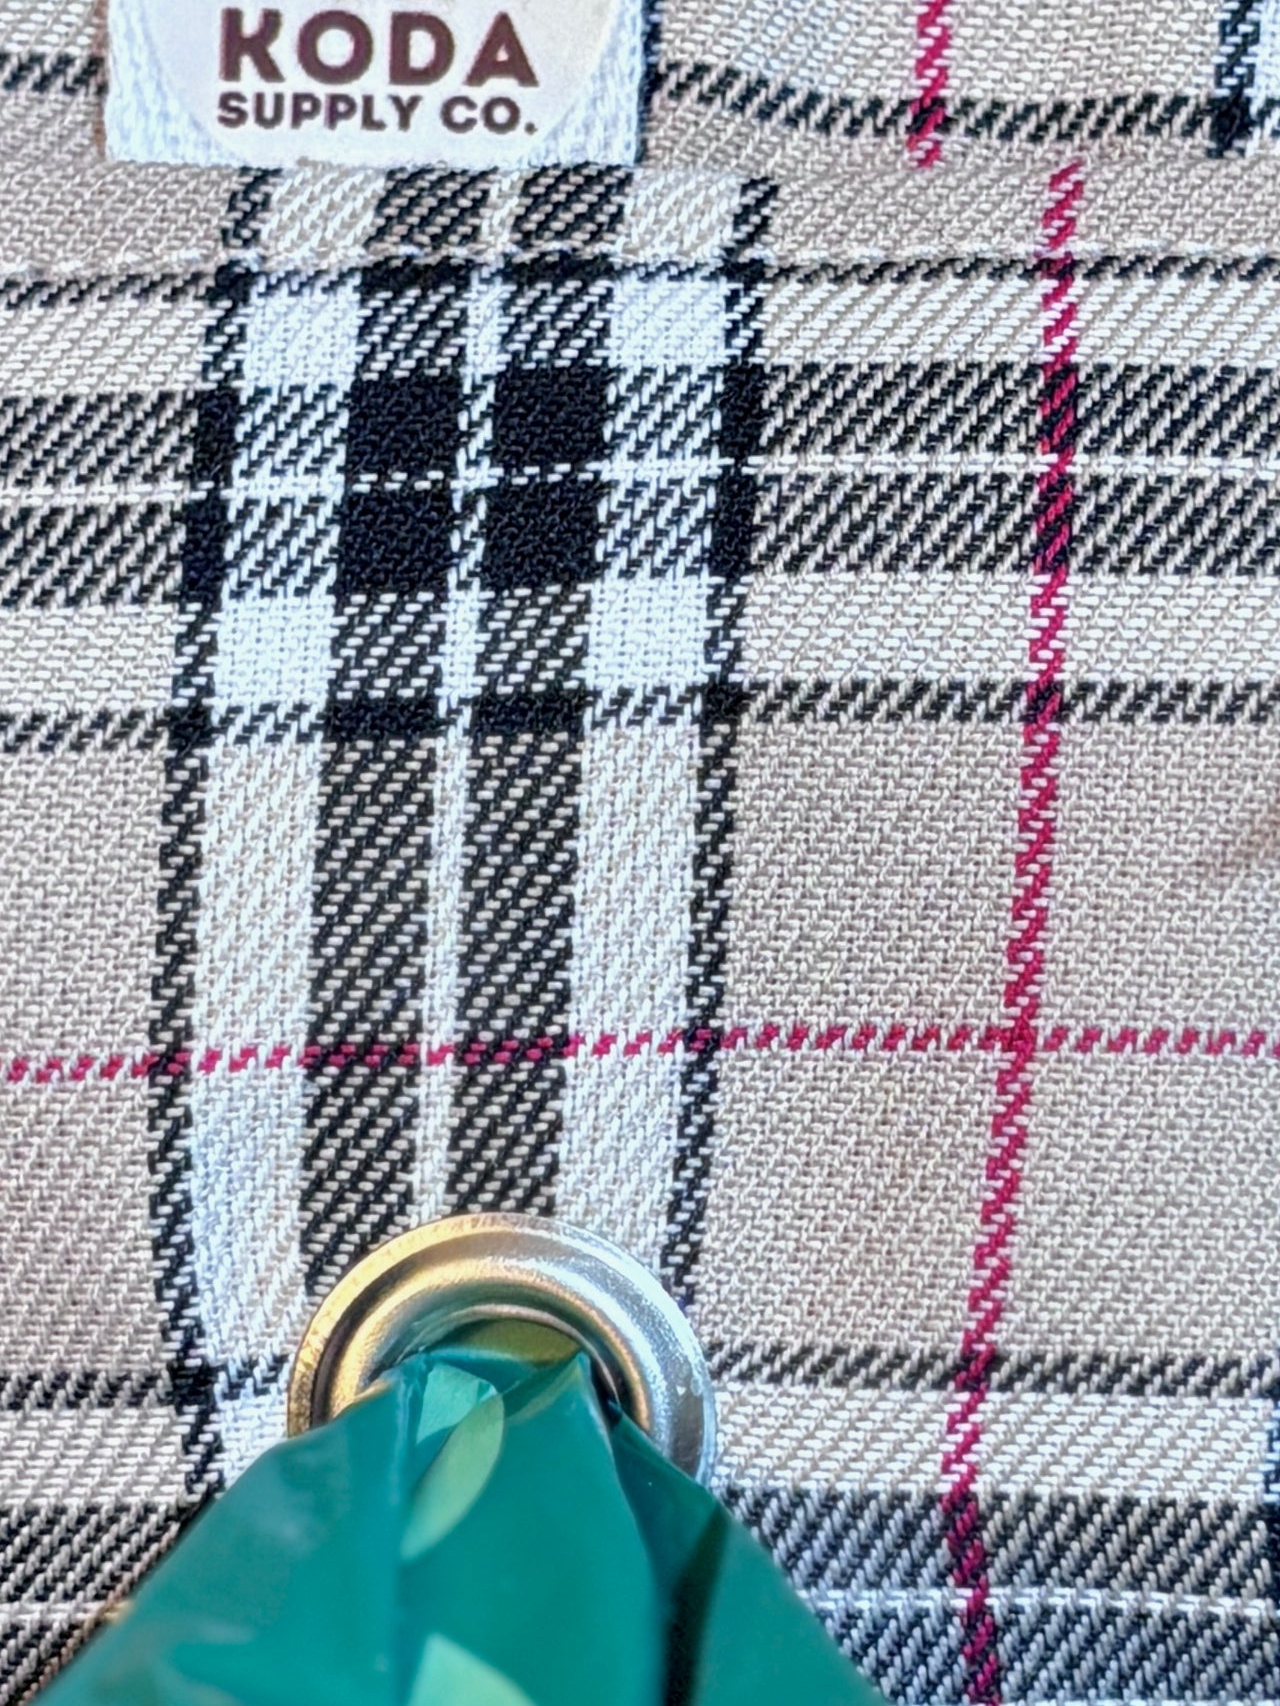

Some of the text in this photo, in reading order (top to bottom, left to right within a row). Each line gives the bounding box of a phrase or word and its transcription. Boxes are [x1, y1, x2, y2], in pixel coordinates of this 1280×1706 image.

[219, 7, 540, 87] KODA
[217, 91, 538, 134] SUPPLY CO.
